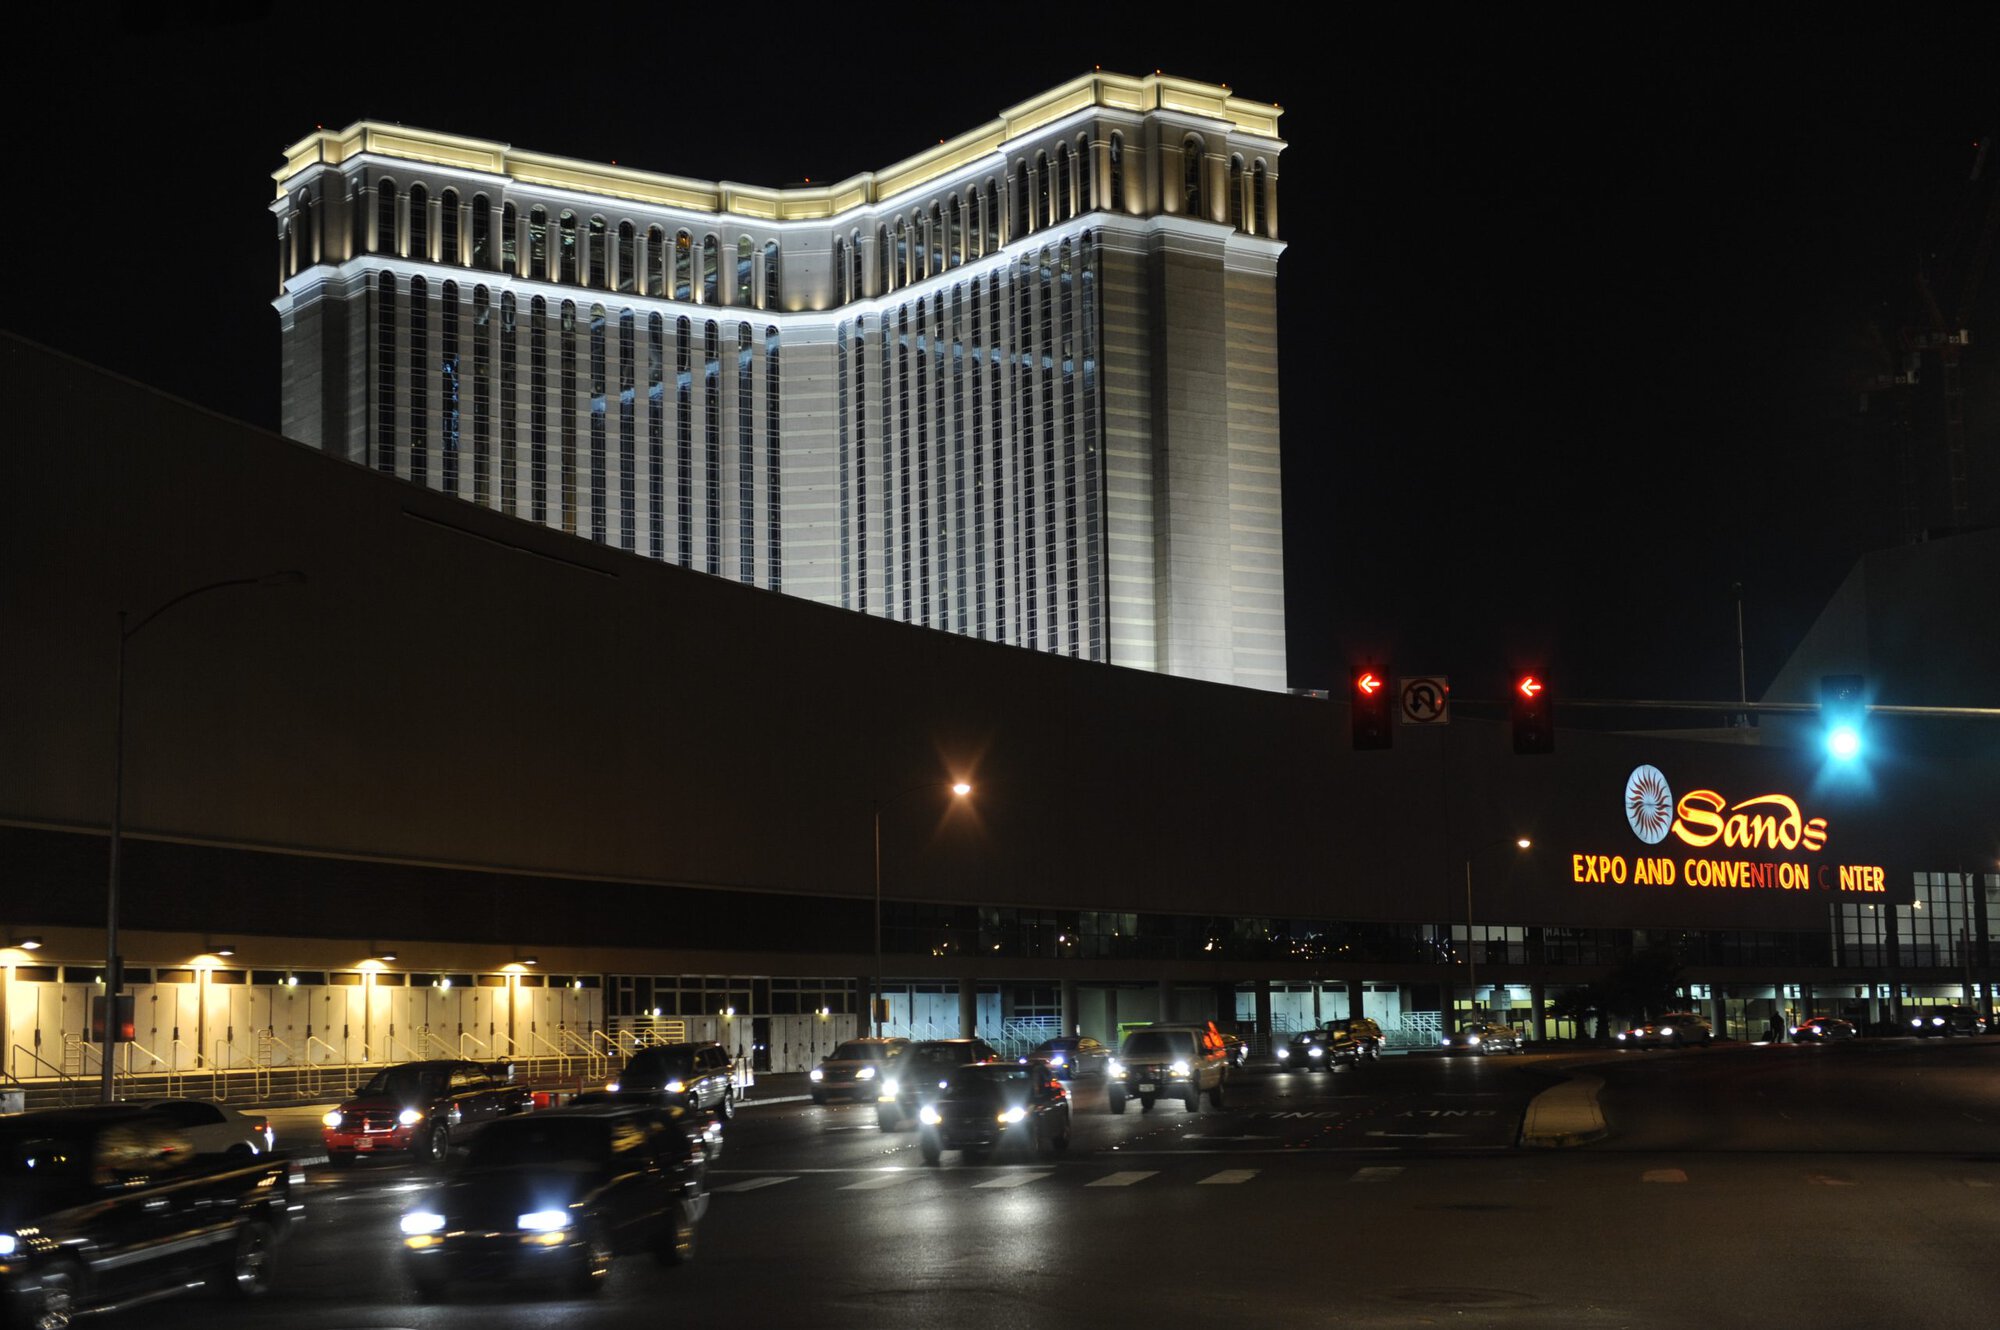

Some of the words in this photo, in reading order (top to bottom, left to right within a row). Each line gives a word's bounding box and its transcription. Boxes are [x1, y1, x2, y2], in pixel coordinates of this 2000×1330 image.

[1671, 788, 1829, 852] Sands
[1572, 853, 1627, 885] EXPO
[1633, 857, 1677, 886] AND
[1683, 858, 1810, 890] CONVENTION
[1817, 864, 1886, 892] CNTER
[1394, 1110, 1497, 1118] ONLY
